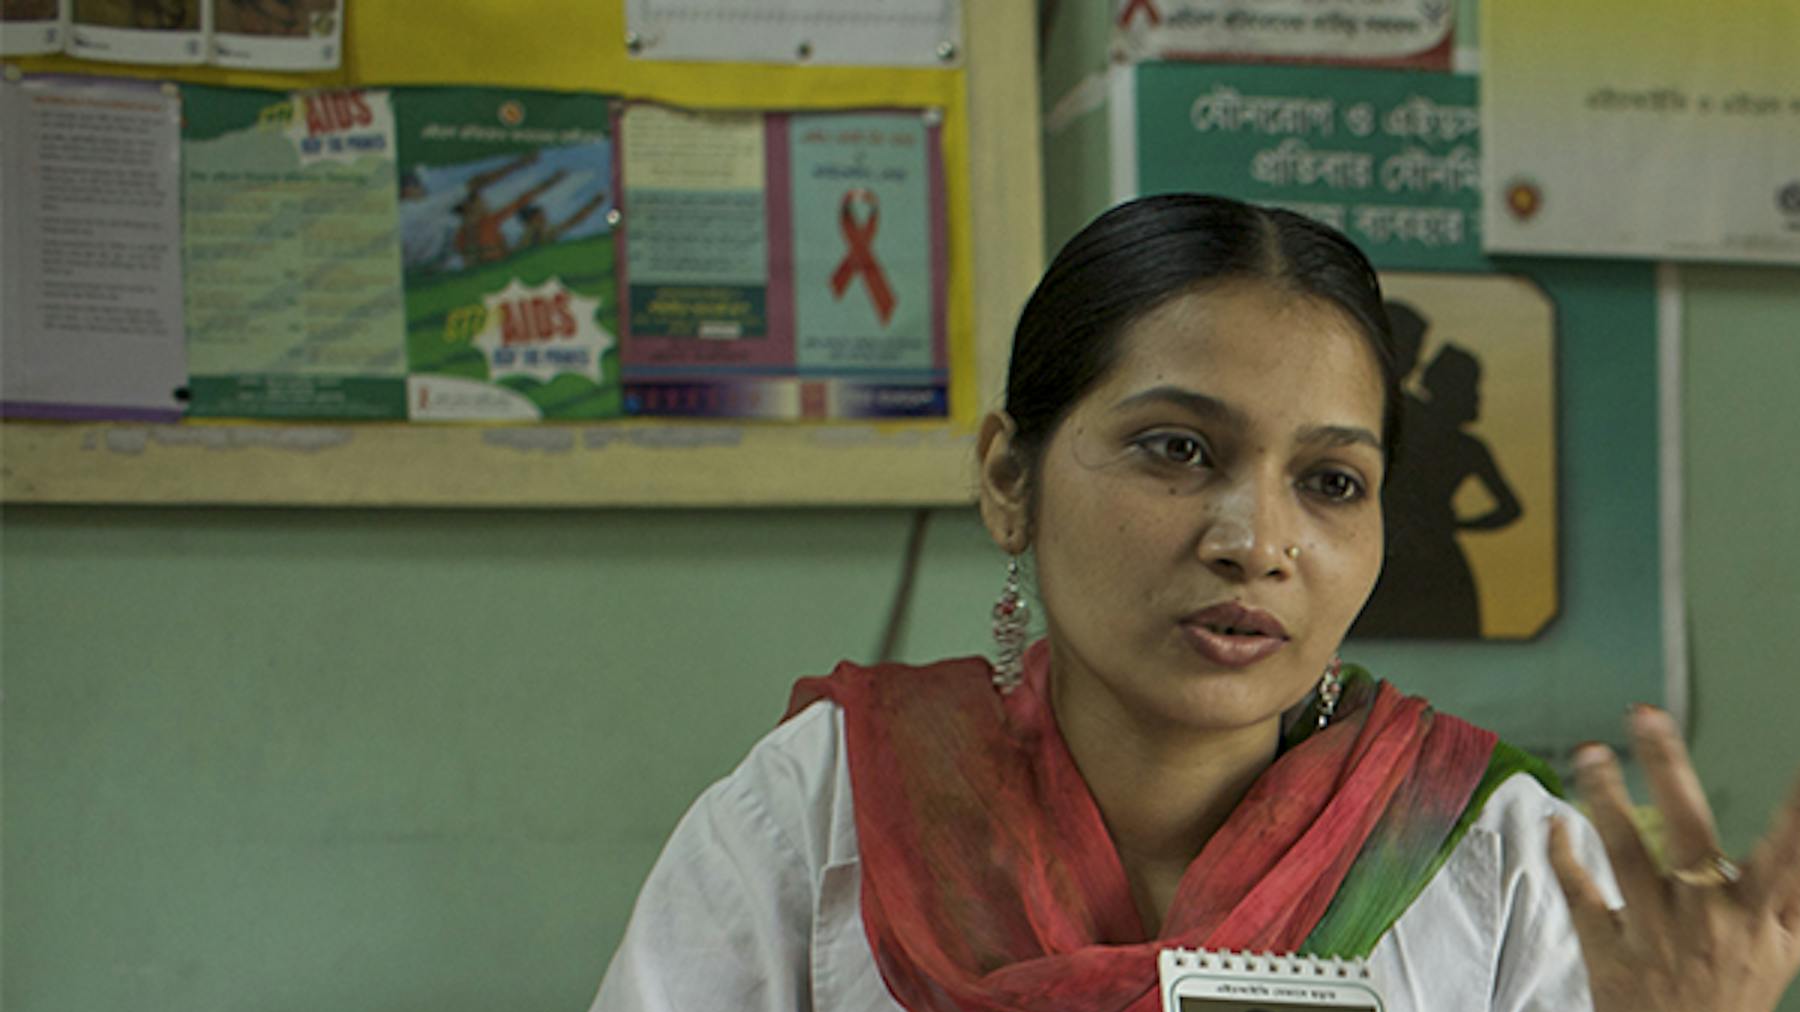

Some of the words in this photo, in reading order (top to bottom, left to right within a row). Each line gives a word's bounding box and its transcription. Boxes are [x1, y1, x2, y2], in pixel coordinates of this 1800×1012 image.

[305, 90, 373, 138] AIDS
[1190, 83, 1335, 136] যৌনরোগ
[1344, 100, 1377, 137] ও
[500, 289, 578, 347] AIDS
